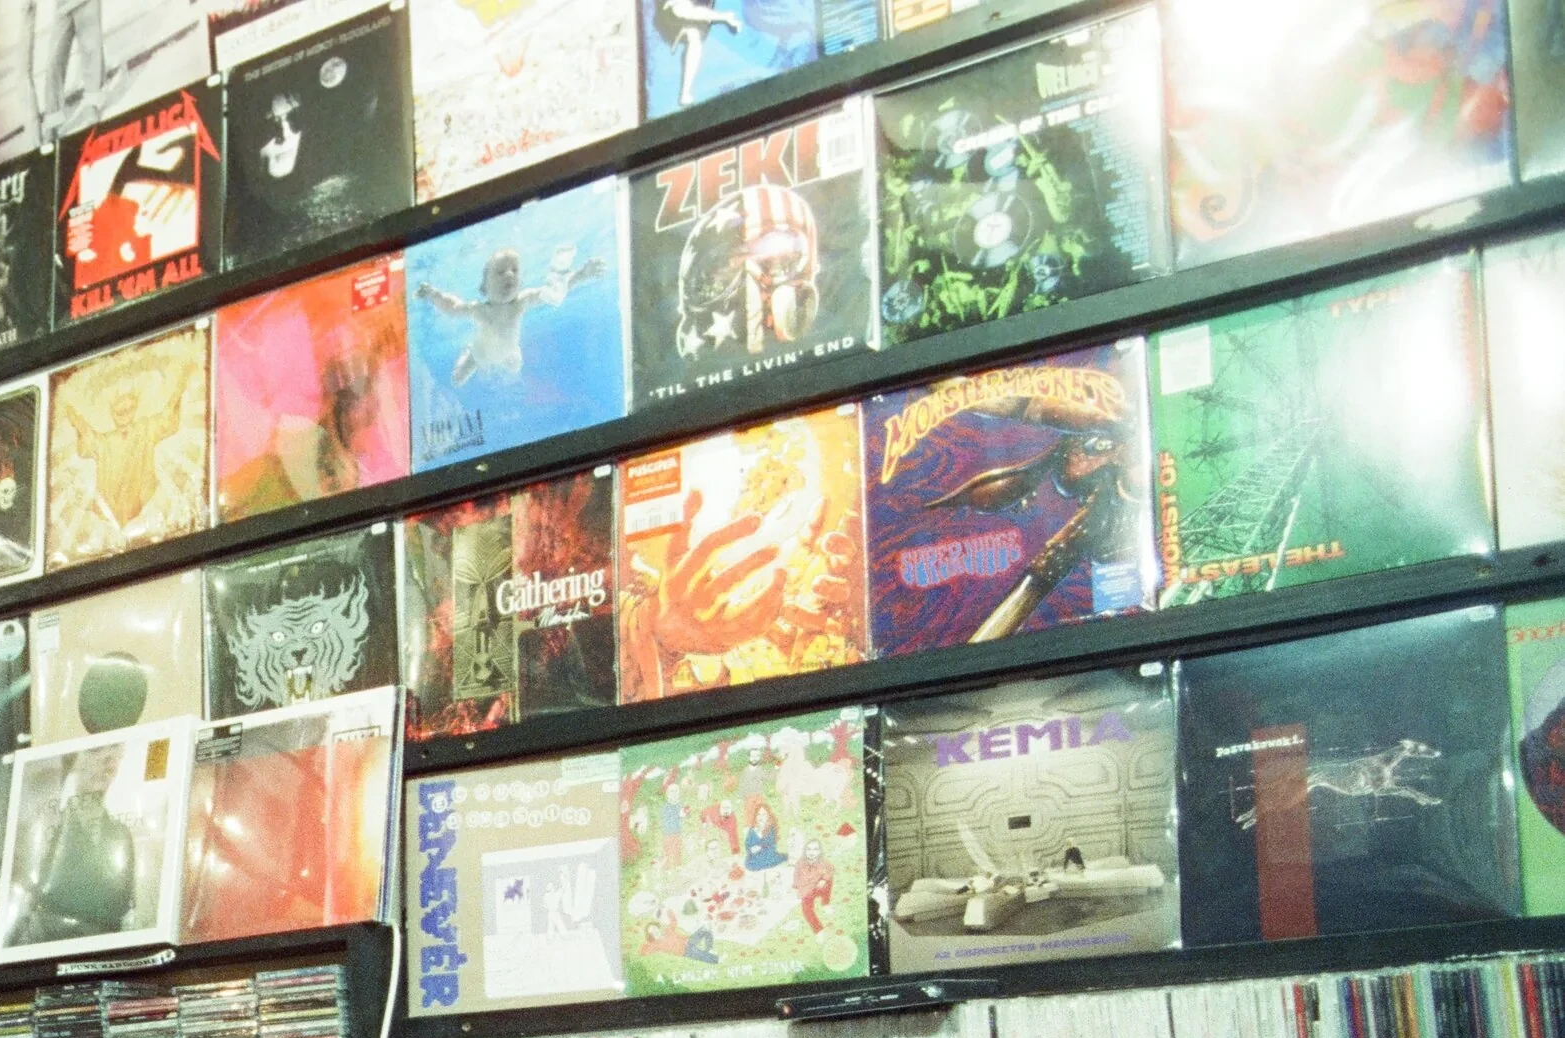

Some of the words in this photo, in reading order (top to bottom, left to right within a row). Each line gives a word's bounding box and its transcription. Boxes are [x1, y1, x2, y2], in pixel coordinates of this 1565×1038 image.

[59, 90, 221, 222] METALLICA
[70, 287, 115, 319] KILL
[161, 254, 203, 289] ALL
[649, 384, 687, 400] 'TIL
[697, 369, 733, 388] THE
[743, 350, 800, 378] LIVIN'
[814, 336, 855, 356] END
[1159, 451, 1178, 487] OF
[1183, 552, 1279, 584] LEAST
[1284, 540, 1346, 567] THE
[496, 566, 607, 615] Gathering
[935, 711, 1134, 768] KEMIA
